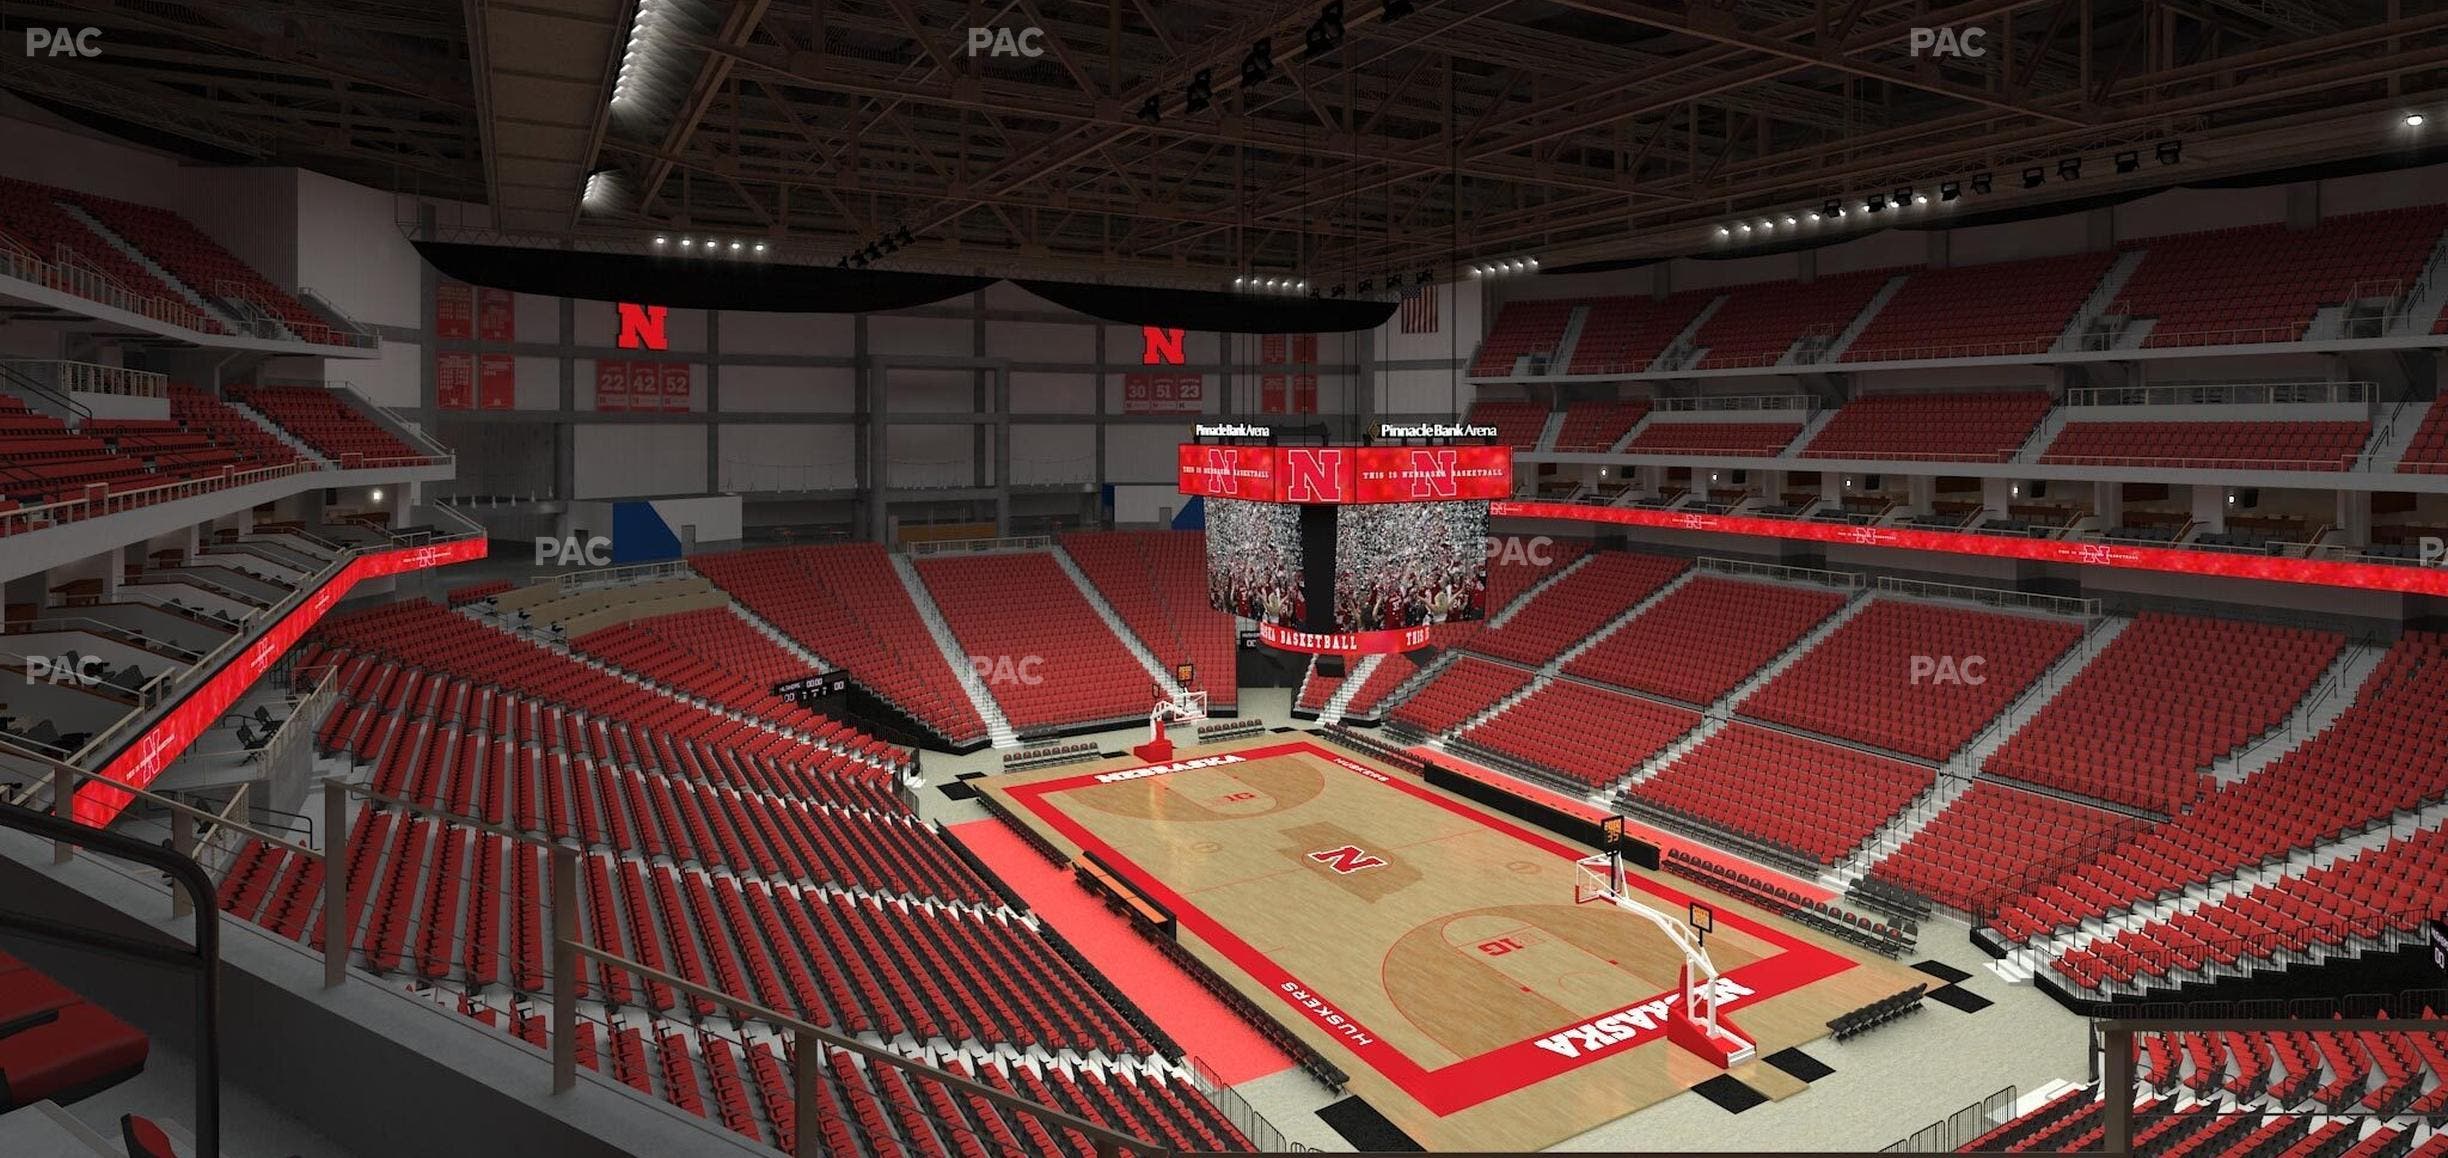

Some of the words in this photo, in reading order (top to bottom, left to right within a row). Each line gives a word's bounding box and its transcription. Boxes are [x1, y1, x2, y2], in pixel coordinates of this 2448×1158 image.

[617, 302, 668, 351] N
[1143, 326, 1185, 365] N
[633, 376, 656, 392] 42
[1196, 424, 1227, 436] Pinnacle
[1226, 424, 1246, 436] Bank
[1246, 424, 1270, 437] Arena
[1381, 424, 1434, 437] Pinnacle
[1434, 424, 1464, 437] Bank
[1463, 425, 1497, 437] Arena
[1209, 449, 1237, 494] N
[1288, 450, 1341, 501] N
[1402, 470, 1446, 478] NEBRASKA
[1451, 469, 1504, 477] BASKETBALL
[1412, 450, 1457, 497] N
[1280, 630, 1357, 650] BASKETBALL
[1406, 628, 1424, 646] THIS
[1308, 845, 1388, 875] N
[1280, 981, 1374, 1046] HUSKERS
